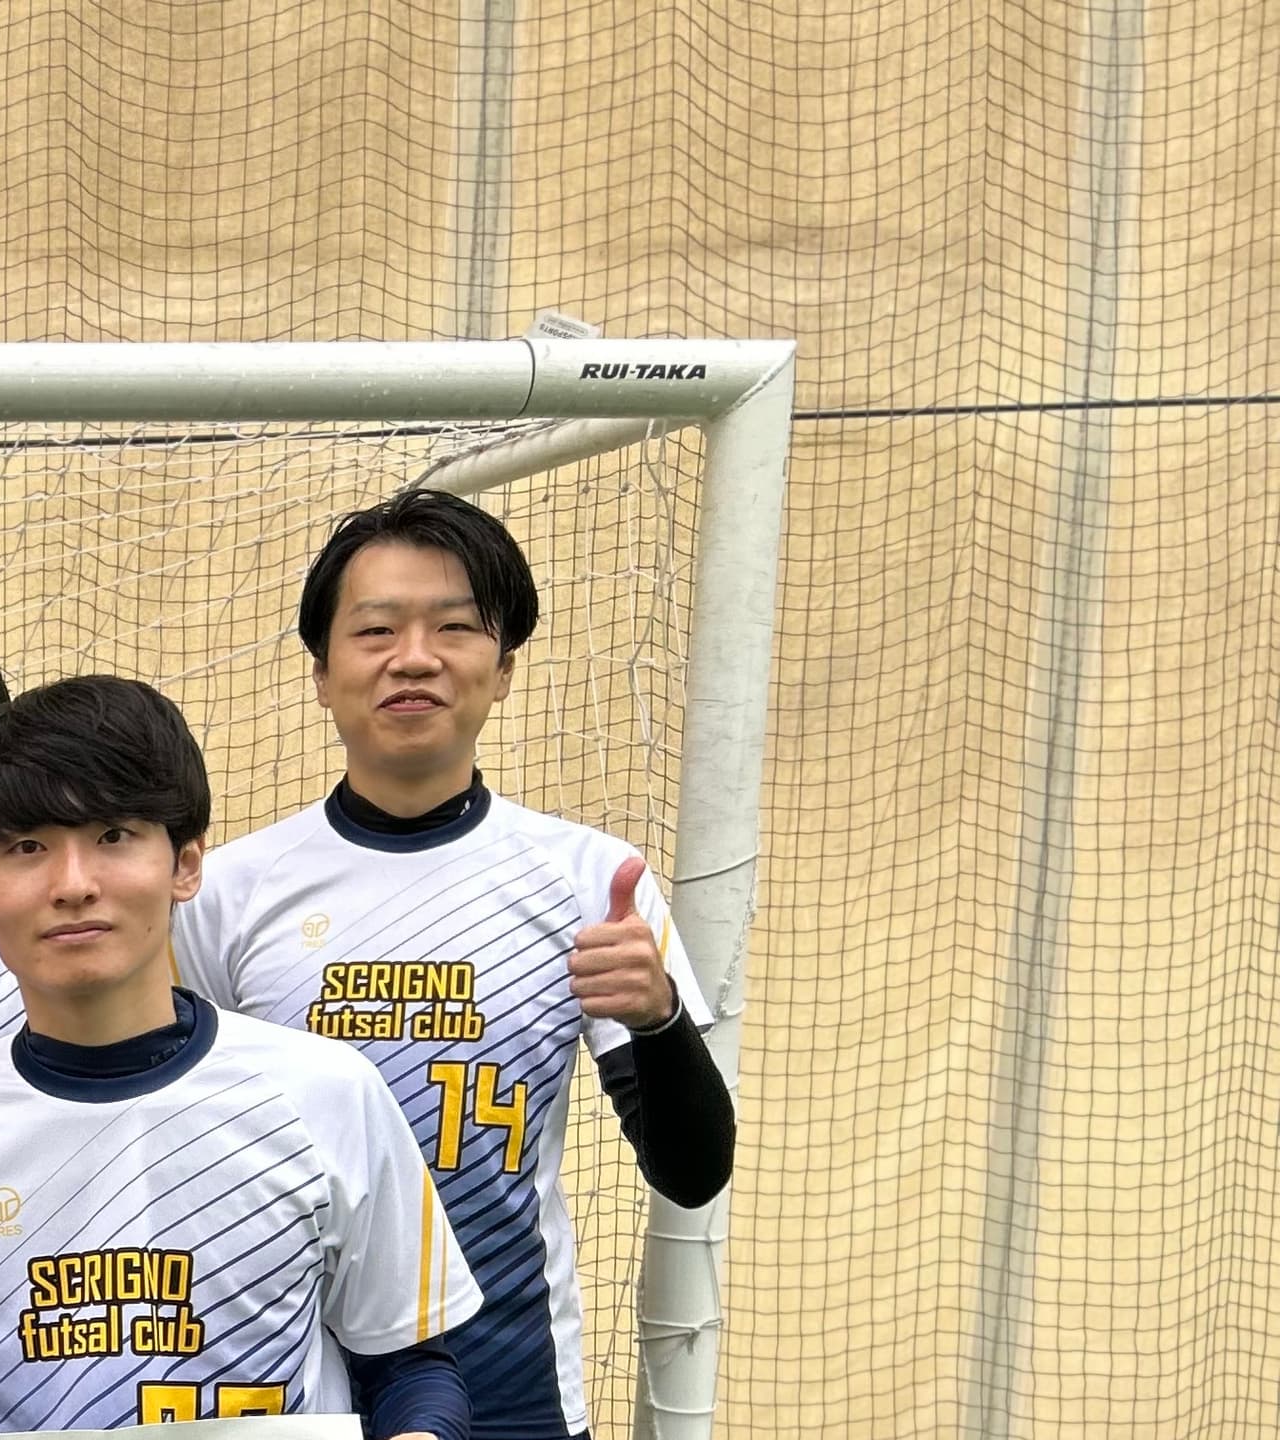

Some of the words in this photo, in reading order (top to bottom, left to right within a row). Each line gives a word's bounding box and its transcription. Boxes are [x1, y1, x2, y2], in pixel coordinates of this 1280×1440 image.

[580, 363, 706, 380] RUI-TAKA
[321, 961, 475, 1002] SCRIGNO
[307, 1003, 405, 1041] futsal
[410, 1000, 485, 1042] club
[427, 1060, 529, 1174] 14
[28, 1248, 193, 1309] SCRIGNO
[19, 1304, 123, 1362] futsal
